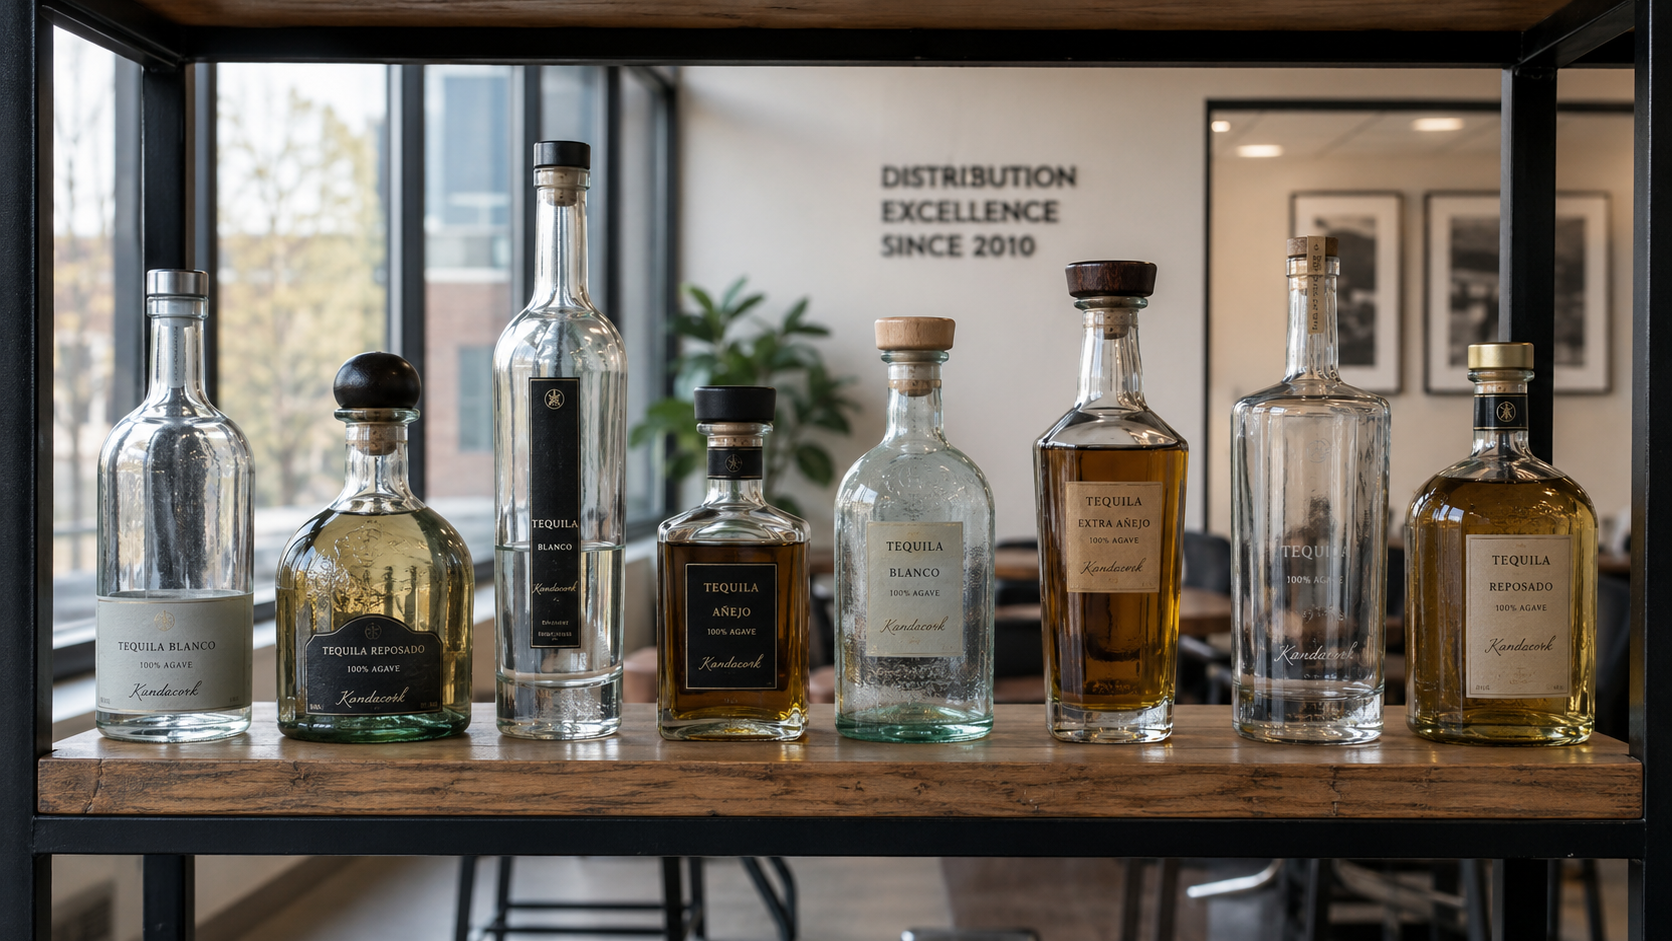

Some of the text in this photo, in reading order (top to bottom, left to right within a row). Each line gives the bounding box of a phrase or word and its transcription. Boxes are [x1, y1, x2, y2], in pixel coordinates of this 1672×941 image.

[881, 165, 1077, 188] DISTRIBUTION
[881, 199, 1059, 223] EXCELLENCE
[881, 234, 1036, 257] SINCE 2010
[1086, 496, 1142, 508] TEQUILA
[531, 519, 578, 530] TEQUILA
[1078, 517, 1150, 530] EXTRA AÑEJO
[1089, 536, 1139, 544] 100% AGAVE
[537, 543, 573, 551] BLANCO
[886, 541, 944, 553] TEQUILA
[1492, 555, 1551, 567] TEQUILA
[889, 567, 940, 578] BLANCO
[1287, 575, 1311, 584] 100%
[703, 582, 759, 594] TEQUILA
[890, 589, 940, 597] 100% AGAVE
[1489, 582, 1554, 592] REPOSADO
[712, 605, 751, 619] AÑEJO
[1495, 604, 1547, 612] 100% AGAVE
[880, 615, 949, 635] Kandacork
[707, 628, 727, 636] 100%
[118, 641, 216, 652] TEQUILA BLANCO
[322, 644, 425, 657] TEQUILA REPOSADO
[140, 661, 193, 669] 100% AGAVE
[347, 664, 401, 673] 100% AGAVE
[698, 653, 764, 672] Kandacork
[129, 680, 203, 701] Kandacork
[335, 686, 409, 709] Kandacork
